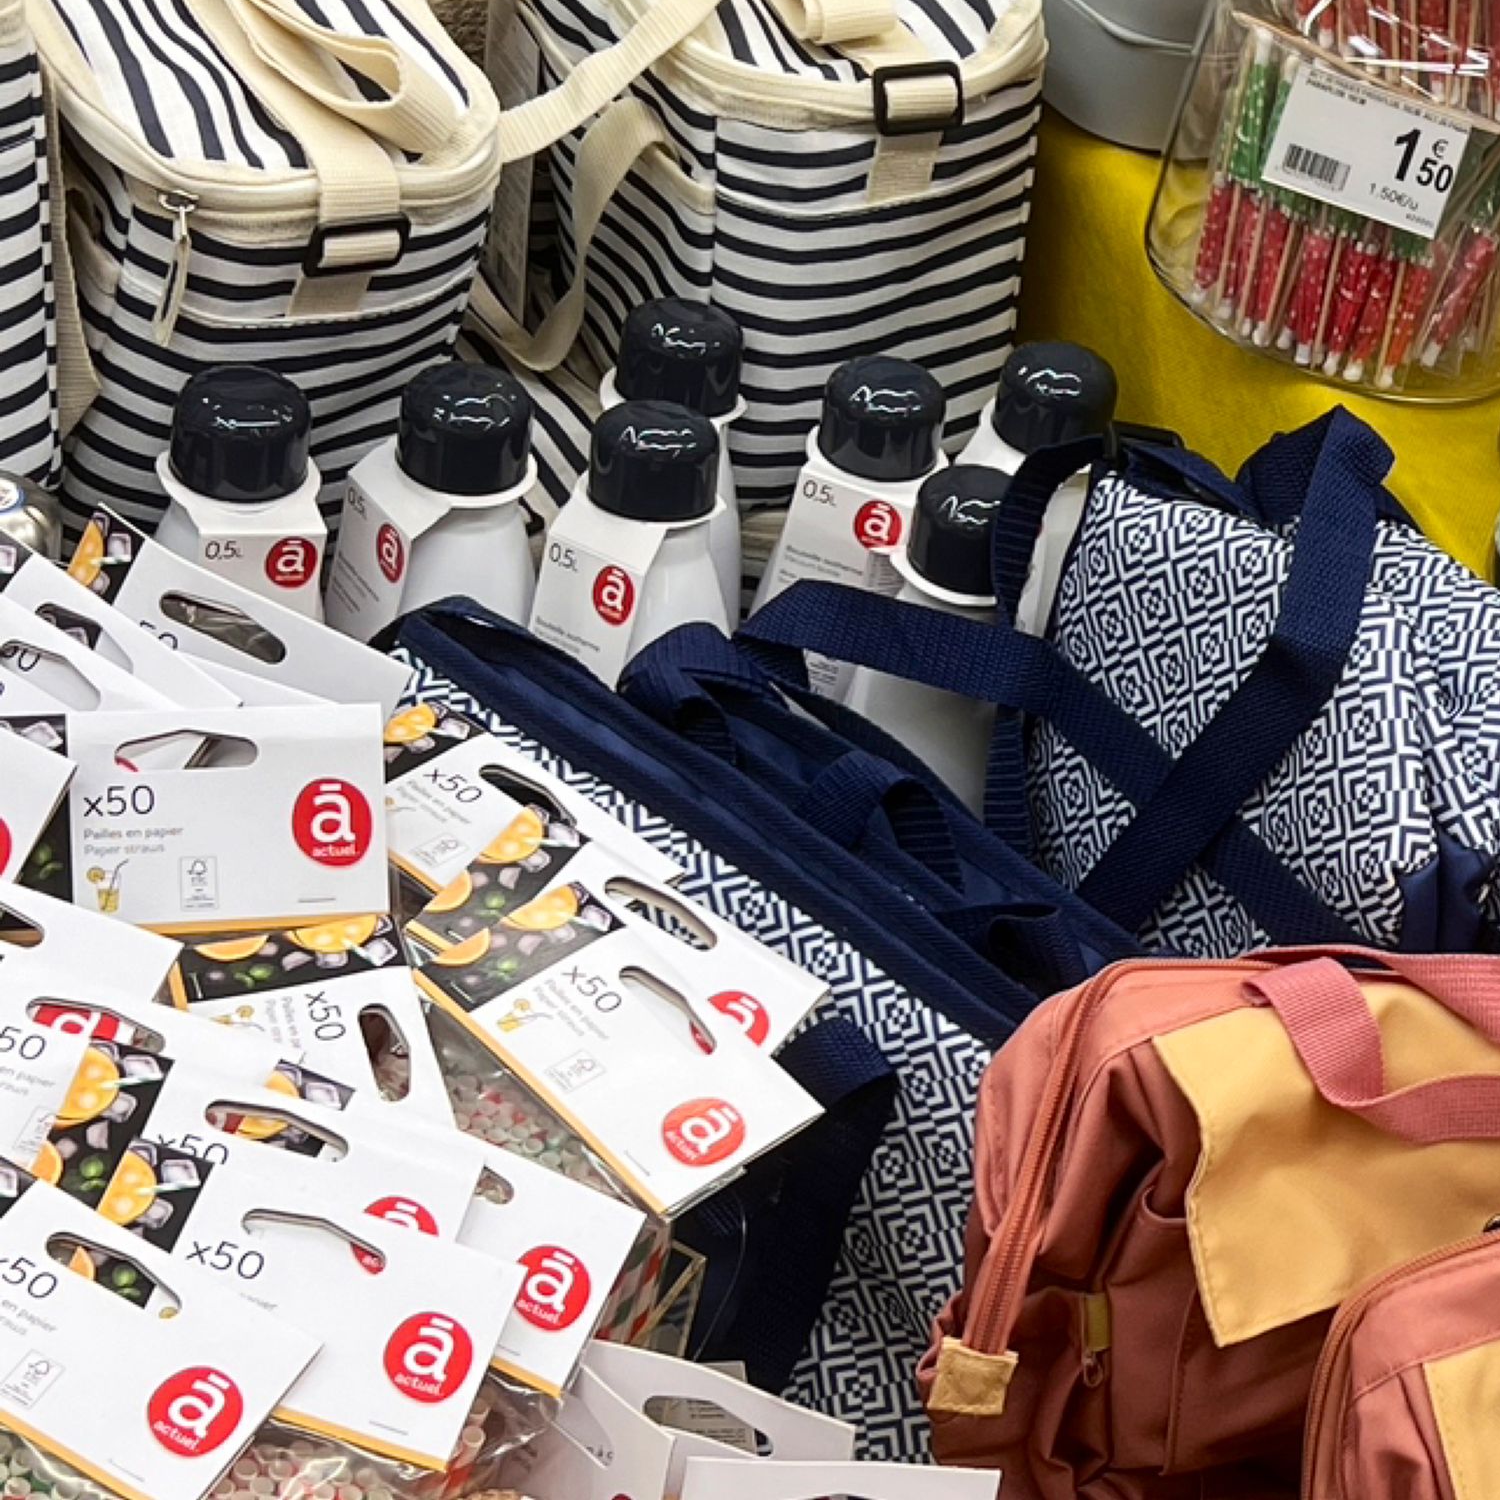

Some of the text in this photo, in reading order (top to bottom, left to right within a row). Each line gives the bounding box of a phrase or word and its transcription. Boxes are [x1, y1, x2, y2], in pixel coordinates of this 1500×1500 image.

[1394, 127, 1421, 183] 1
[1416, 157, 1453, 194] 50
[83, 785, 155, 818] x50
[423, 768, 482, 804] x50
[83, 825, 184, 844] Pailles en papier
[310, 783, 356, 843] ā
[84, 844, 165, 856] Paper straws
[562, 965, 622, 1013] x50
[304, 990, 347, 1042] x50
[186, 1240, 267, 1282] x50
[525, 1249, 575, 1314] ā
[403, 1316, 454, 1383] ā
[168, 1372, 231, 1440] ā
